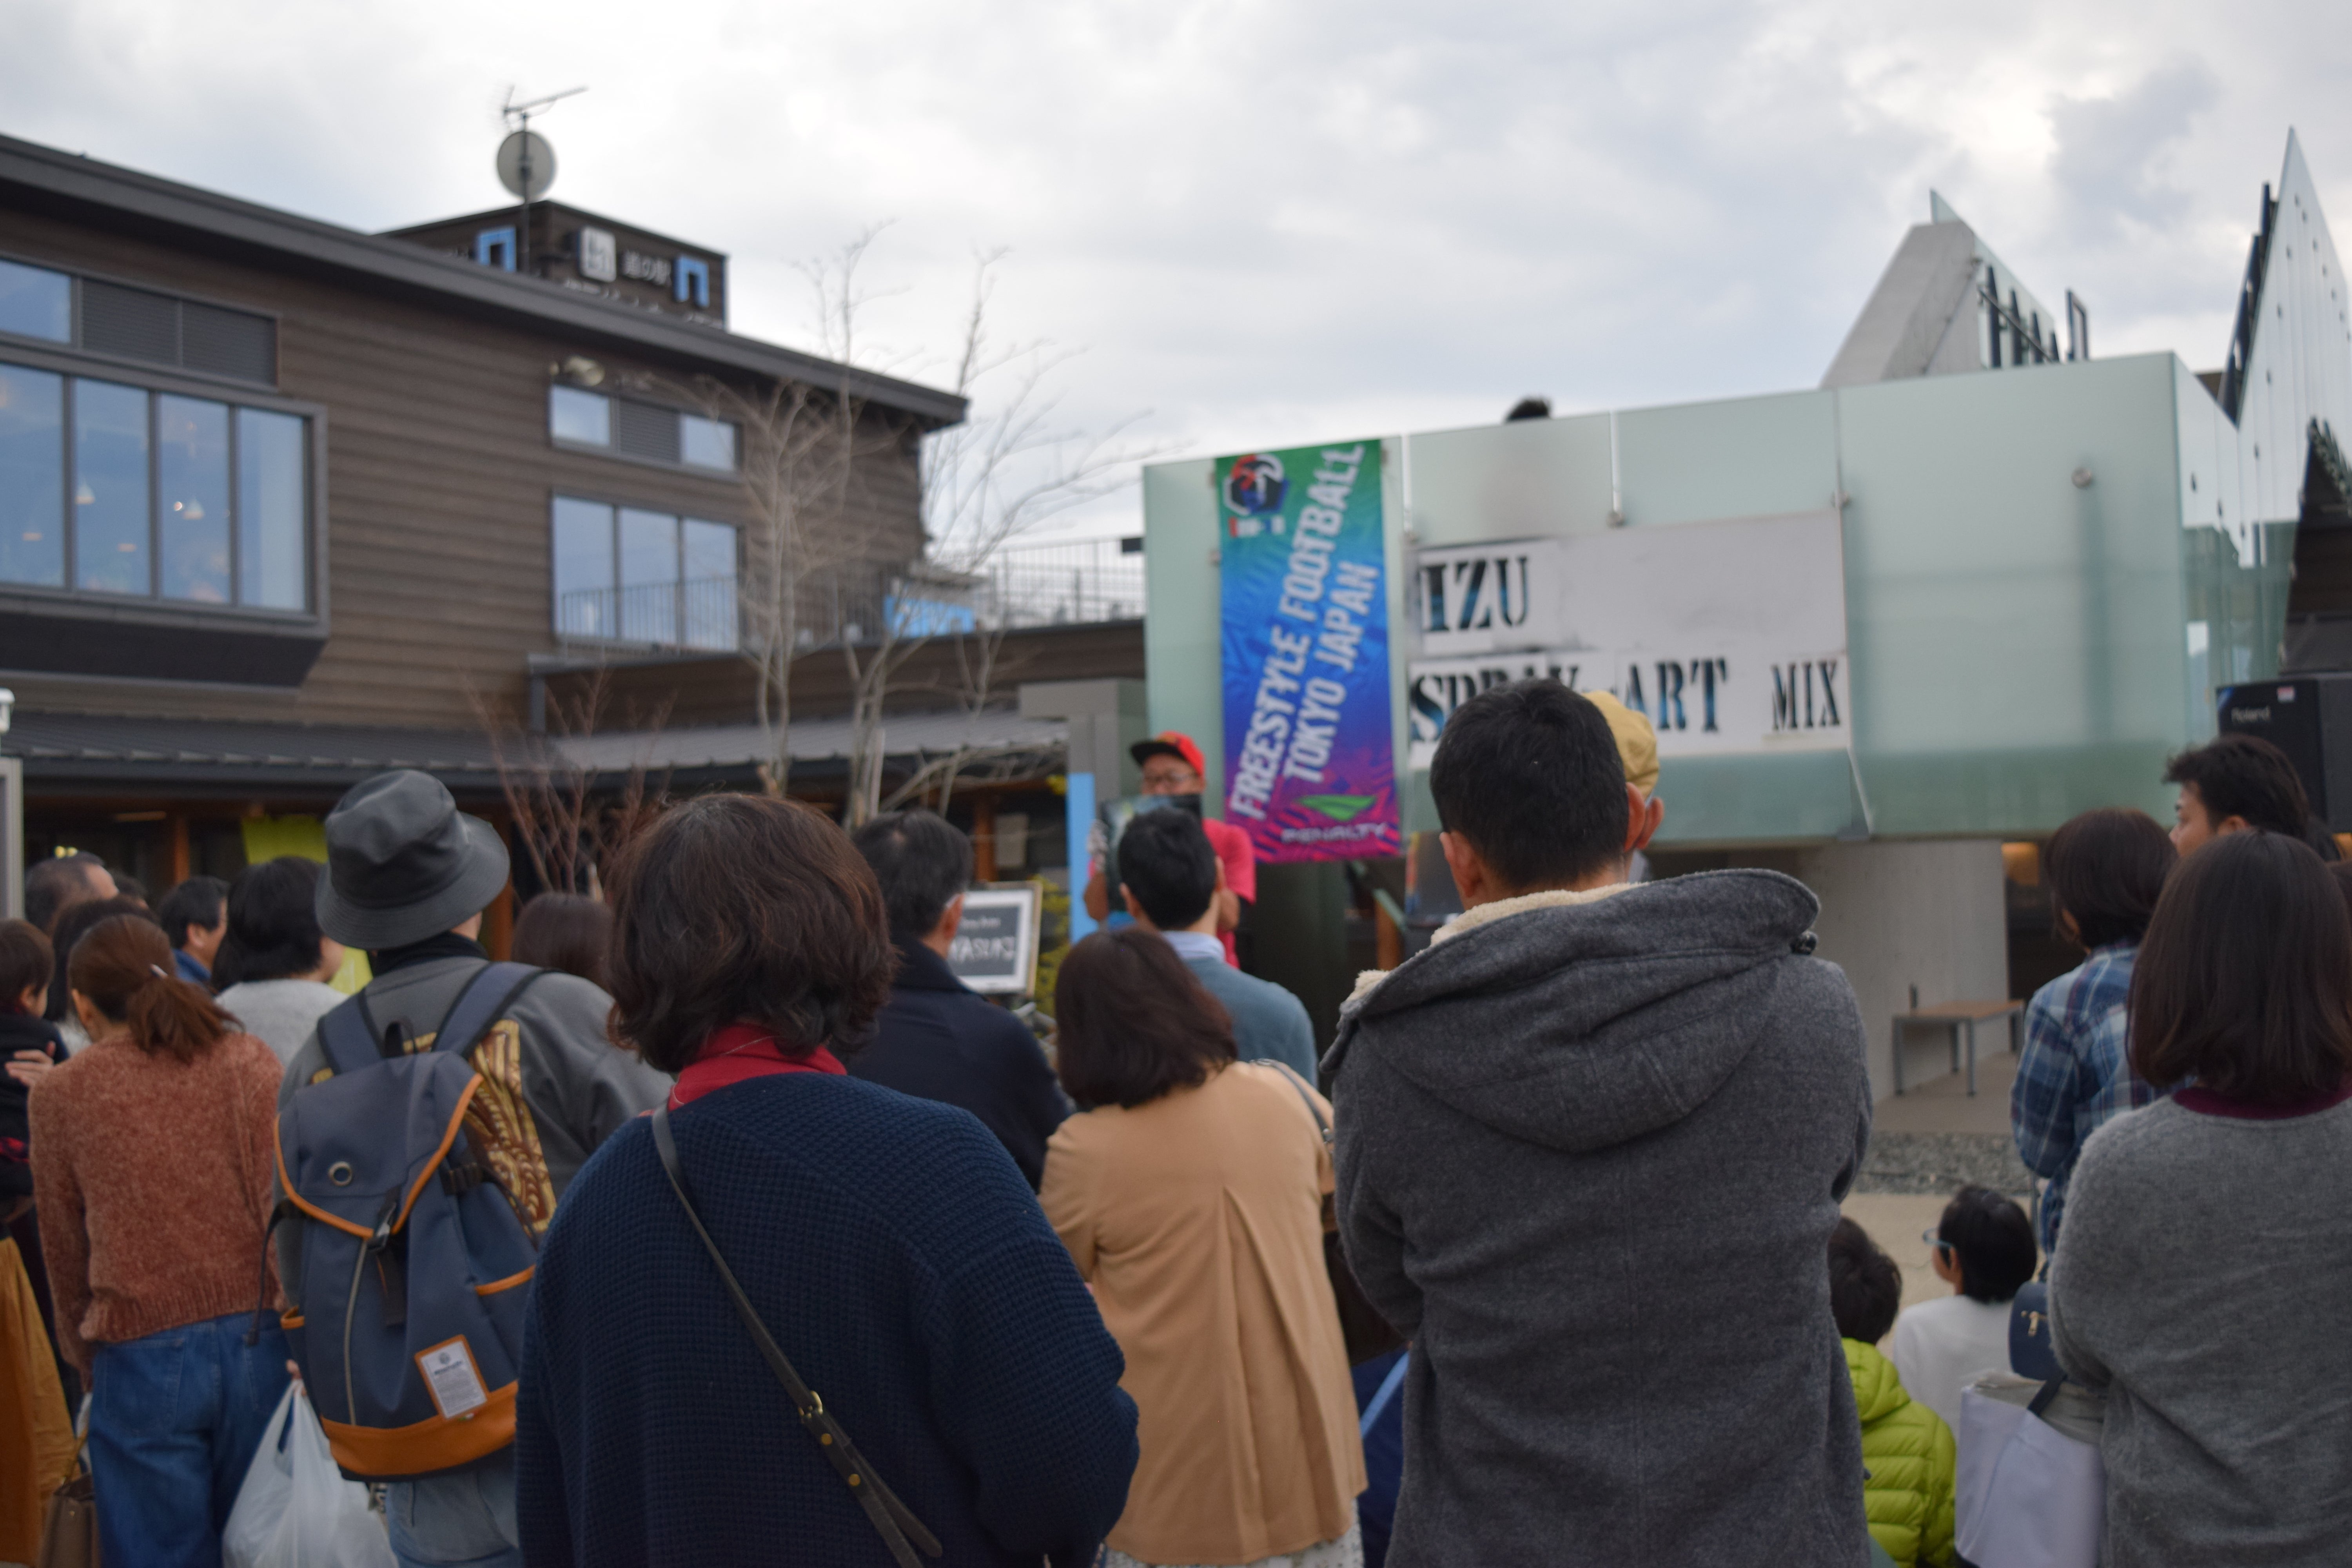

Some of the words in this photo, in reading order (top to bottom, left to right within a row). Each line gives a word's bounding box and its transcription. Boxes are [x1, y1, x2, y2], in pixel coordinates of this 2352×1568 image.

[1229, 625, 1311, 821] FREESTYLE
[1278, 444, 1366, 622] FOOTBALL
[1420, 556, 1528, 632] IZU
[1283, 677, 1347, 783] TOKYO
[1315, 561, 1380, 673] JAPAN
[1624, 655, 1728, 732] ART
[1771, 659, 1840, 730] MIX
